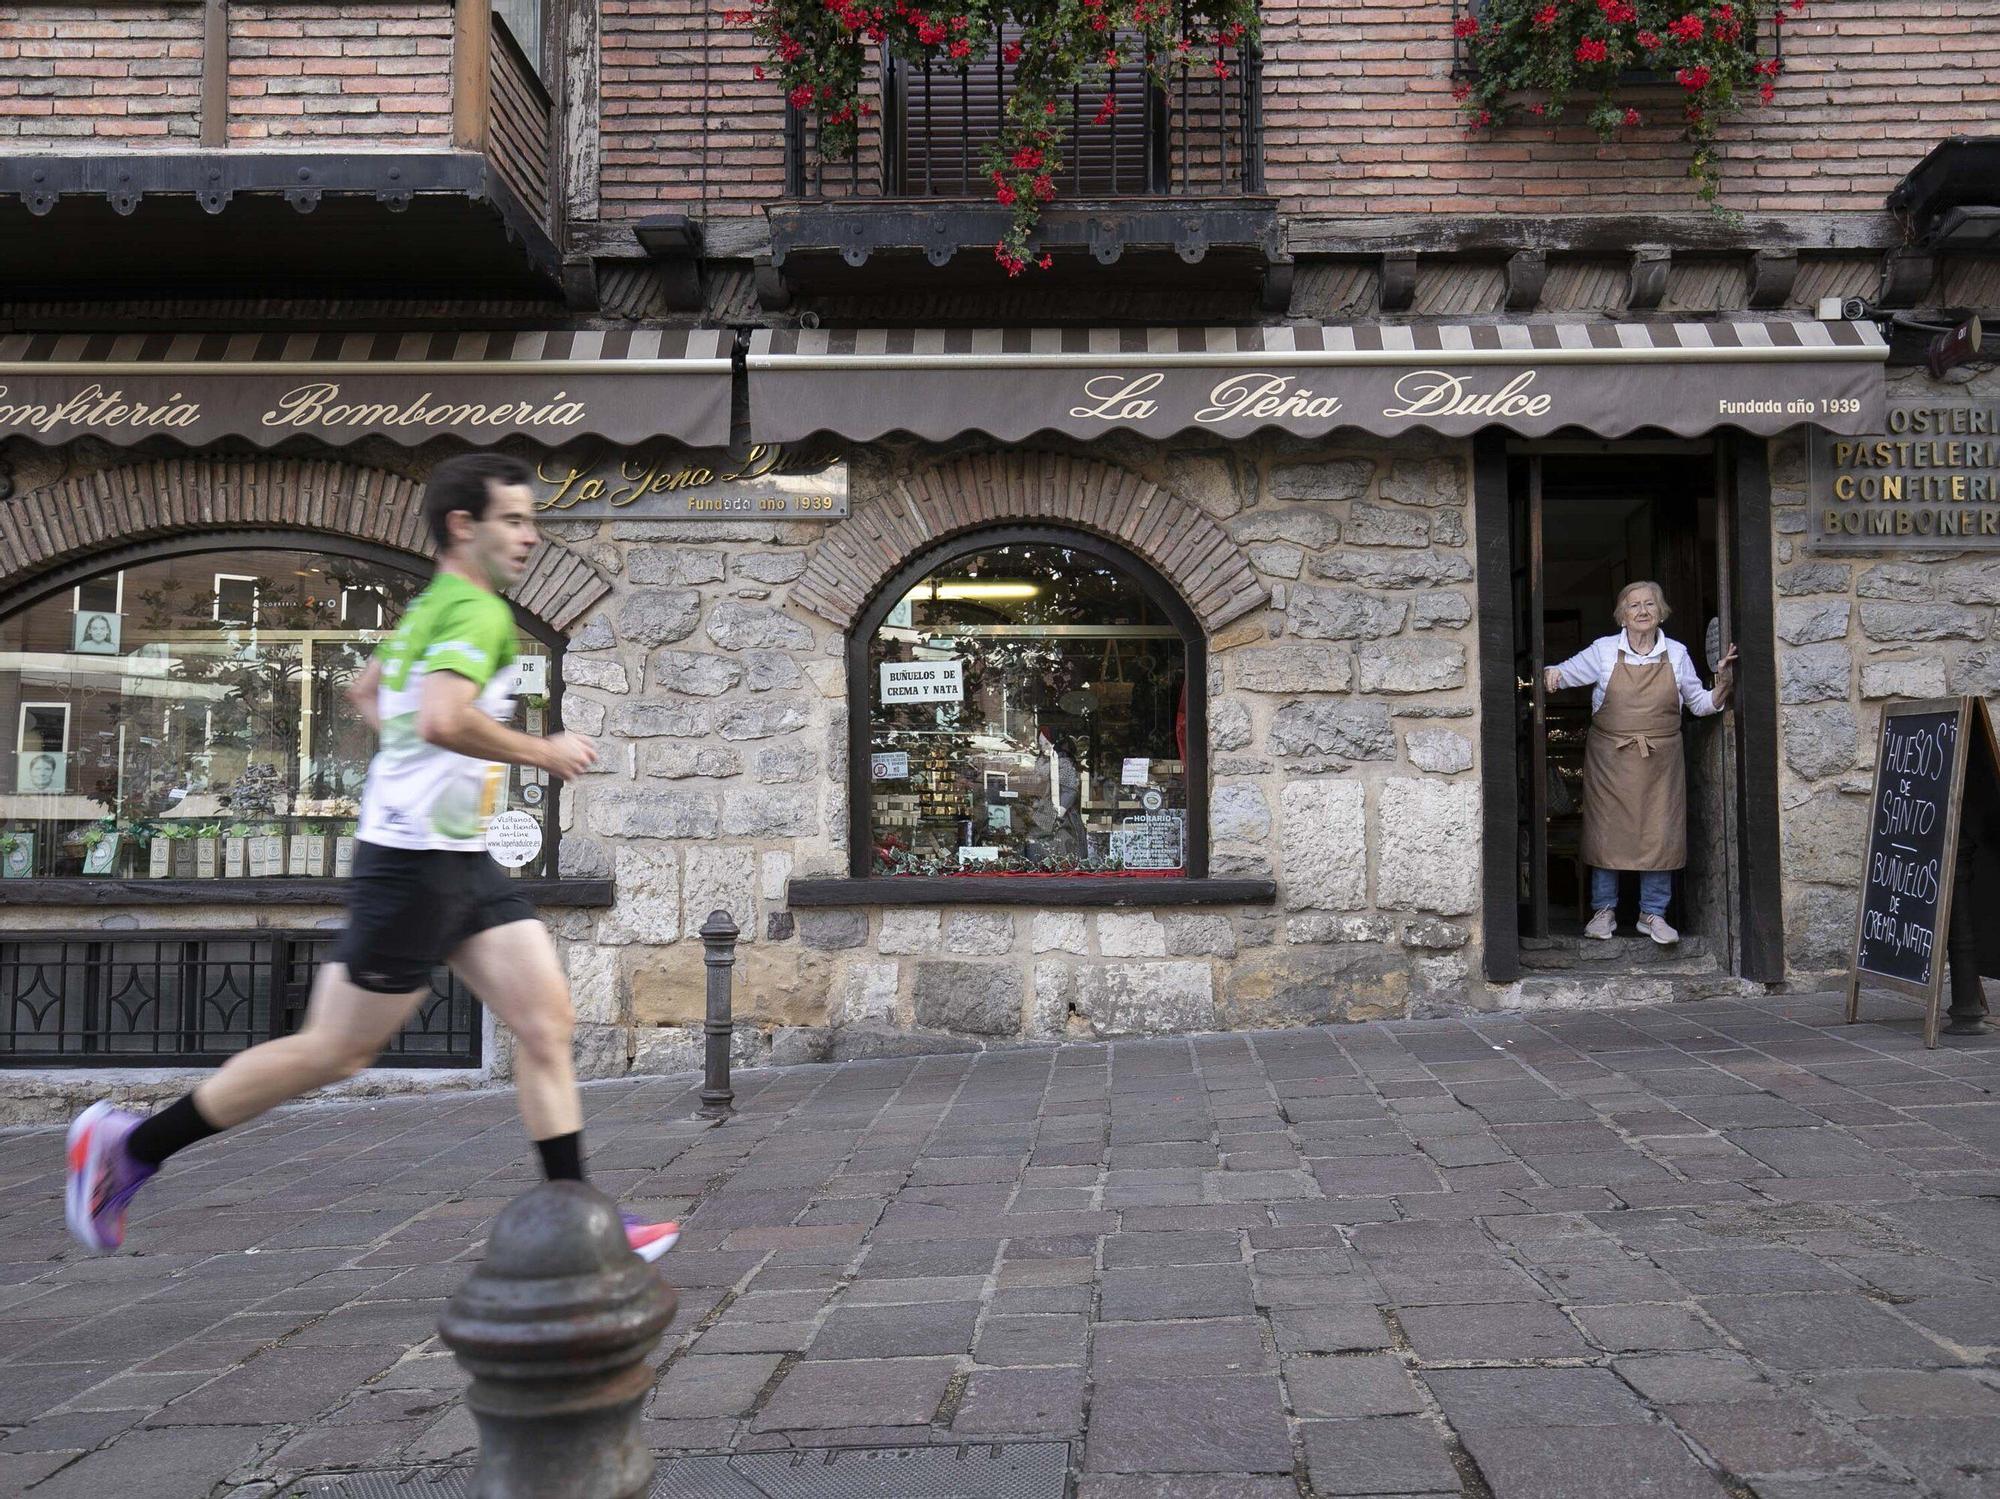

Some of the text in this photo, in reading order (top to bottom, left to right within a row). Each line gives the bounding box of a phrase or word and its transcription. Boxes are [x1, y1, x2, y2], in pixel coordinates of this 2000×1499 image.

[262, 383, 586, 426] Bombonería
[1069, 369, 1552, 423] La Peña Dulce
[1719, 398, 1861, 414] Fundada año 1939
[1889, 407, 2000, 434] OSTERI
[1835, 441, 2000, 468] PASTELERI
[1835, 474, 2000, 502] CONFITERI
[687, 495, 834, 511] Fundada año 1939
[1824, 508, 2000, 536] BOMBONER
[522, 662, 535, 672] DE
[889, 669, 956, 682] BUÑUELOS DE
[887, 685, 959, 697] CREMA Y NATA
[1885, 722, 1947, 781] HUESOS
[1899, 778, 1912, 797] DE
[1879, 789, 1936, 836] SANTO
[1872, 851, 1939, 905] BUÑUELOS
[1889, 895, 1901, 915] DE
[1863, 910, 1897, 947] CREMA
[1902, 921, 1935, 958] NATA
